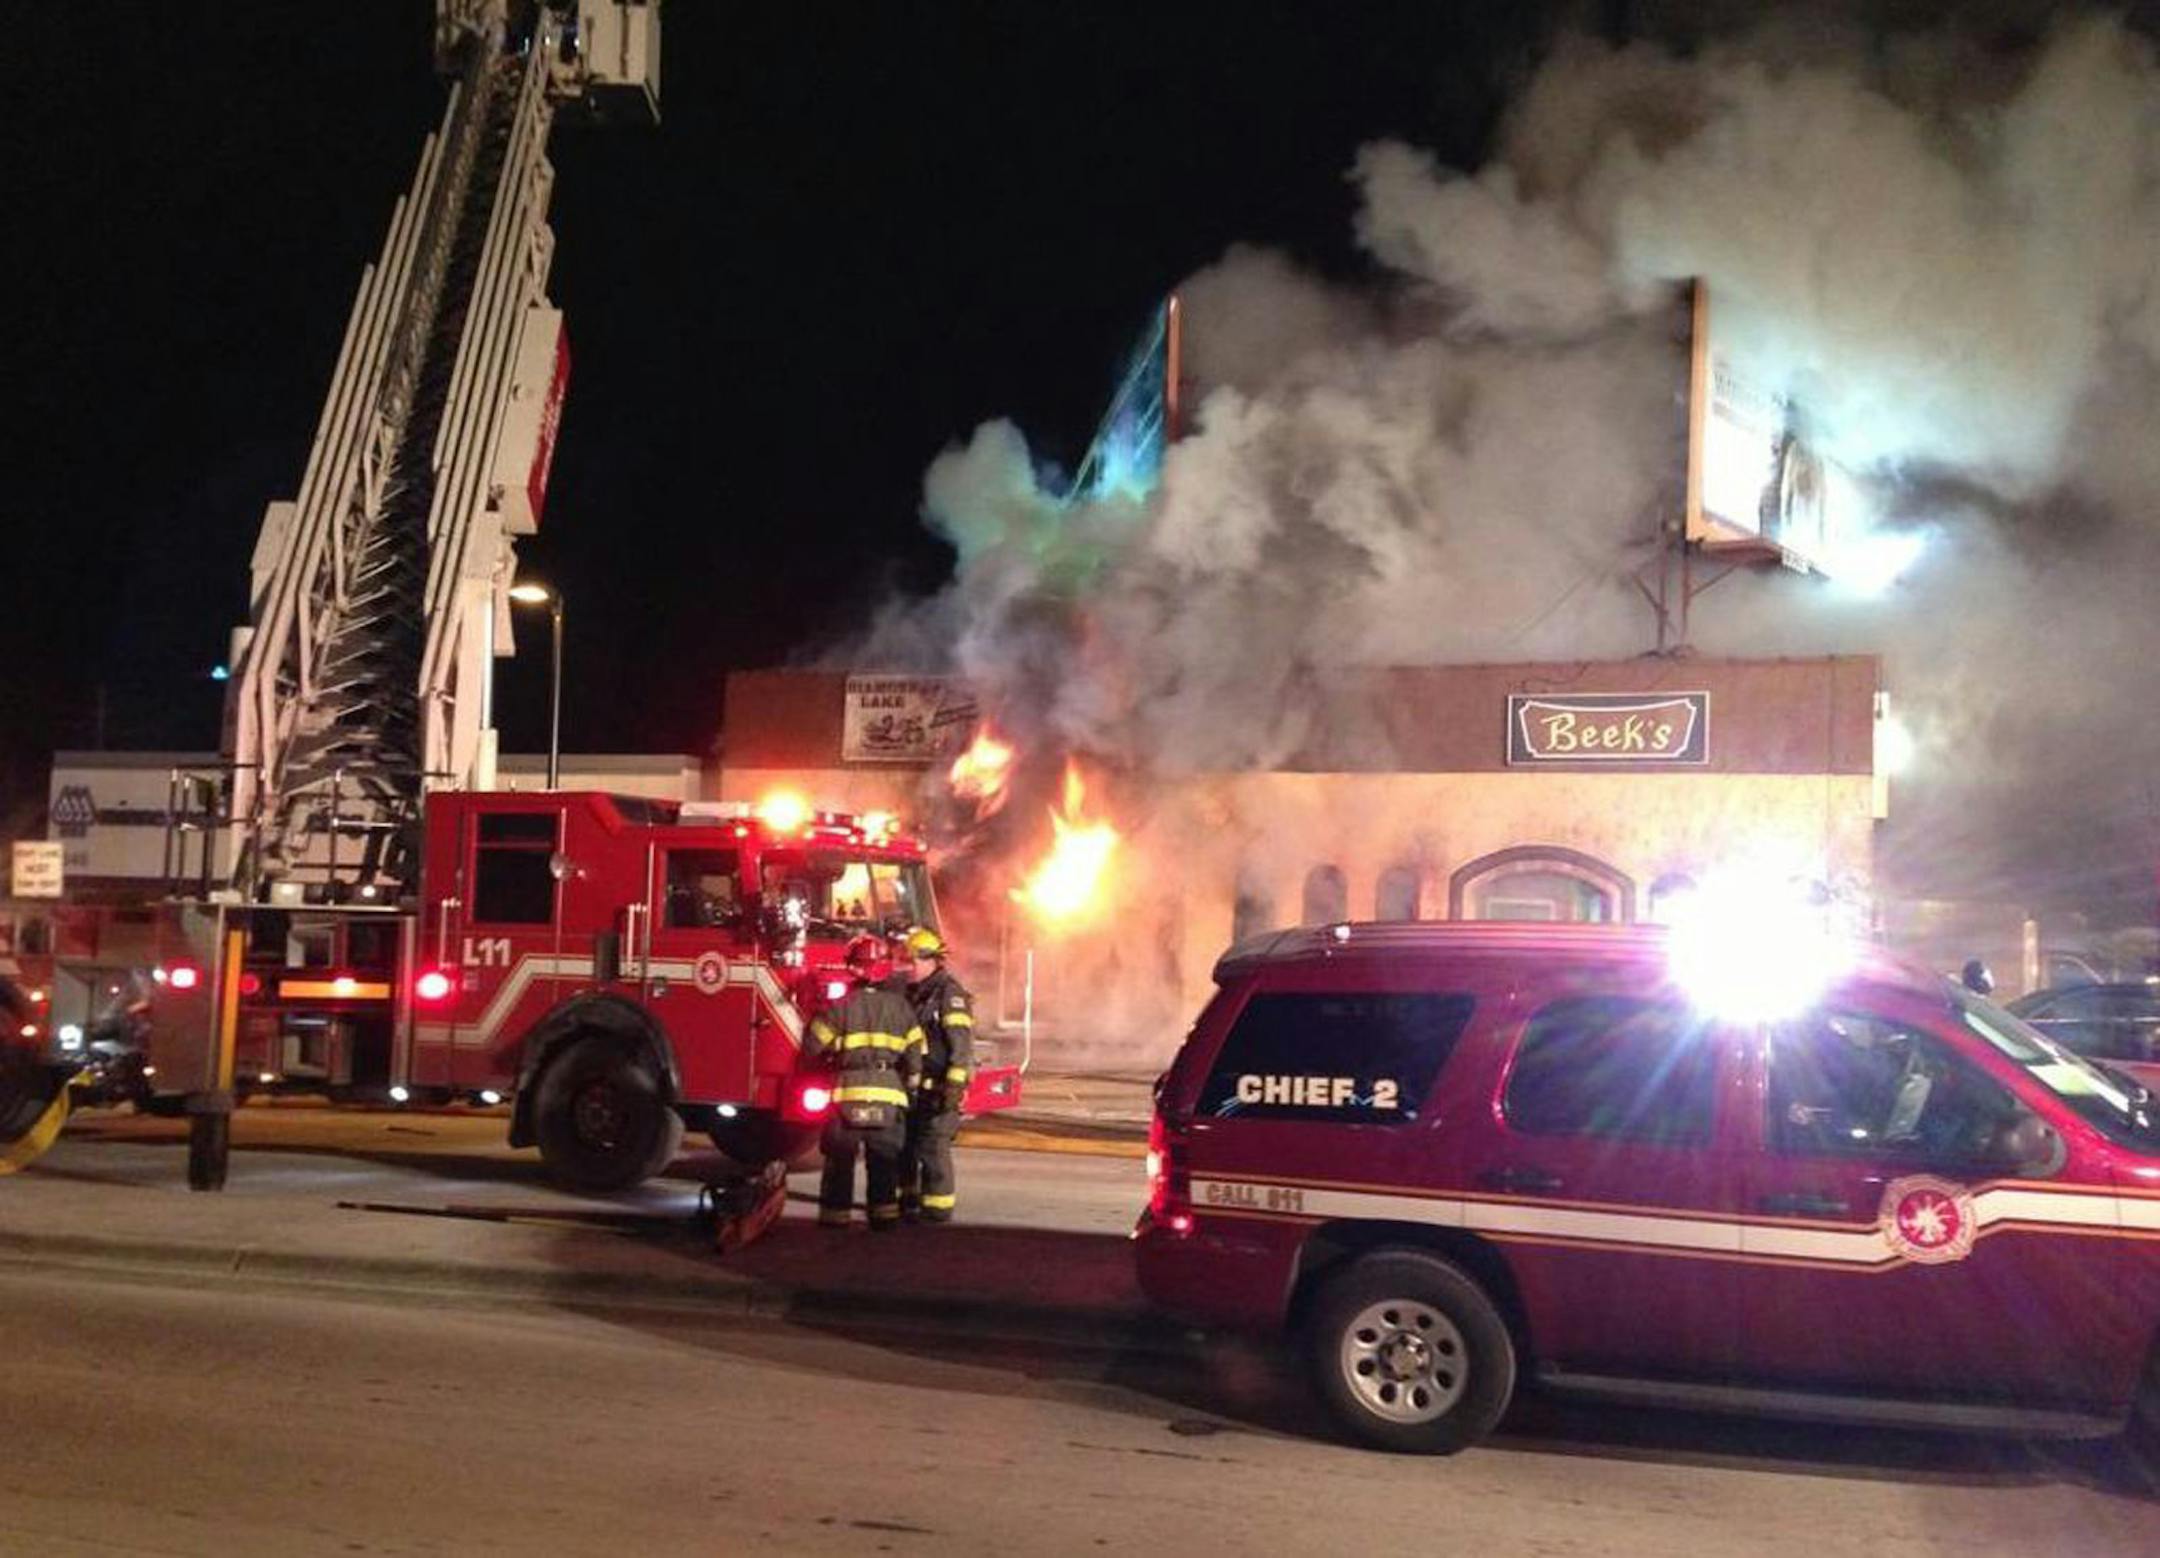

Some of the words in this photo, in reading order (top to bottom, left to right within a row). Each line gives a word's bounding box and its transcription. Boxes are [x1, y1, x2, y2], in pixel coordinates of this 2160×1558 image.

[860, 696, 904, 708] LAKE
[1540, 712, 1673, 751] Beek's
[463, 938, 512, 966] L11
[1236, 1074, 1355, 1106] CHIEF
[1372, 1079, 1399, 1108] 2
[1206, 1183, 1259, 1206] CALL
